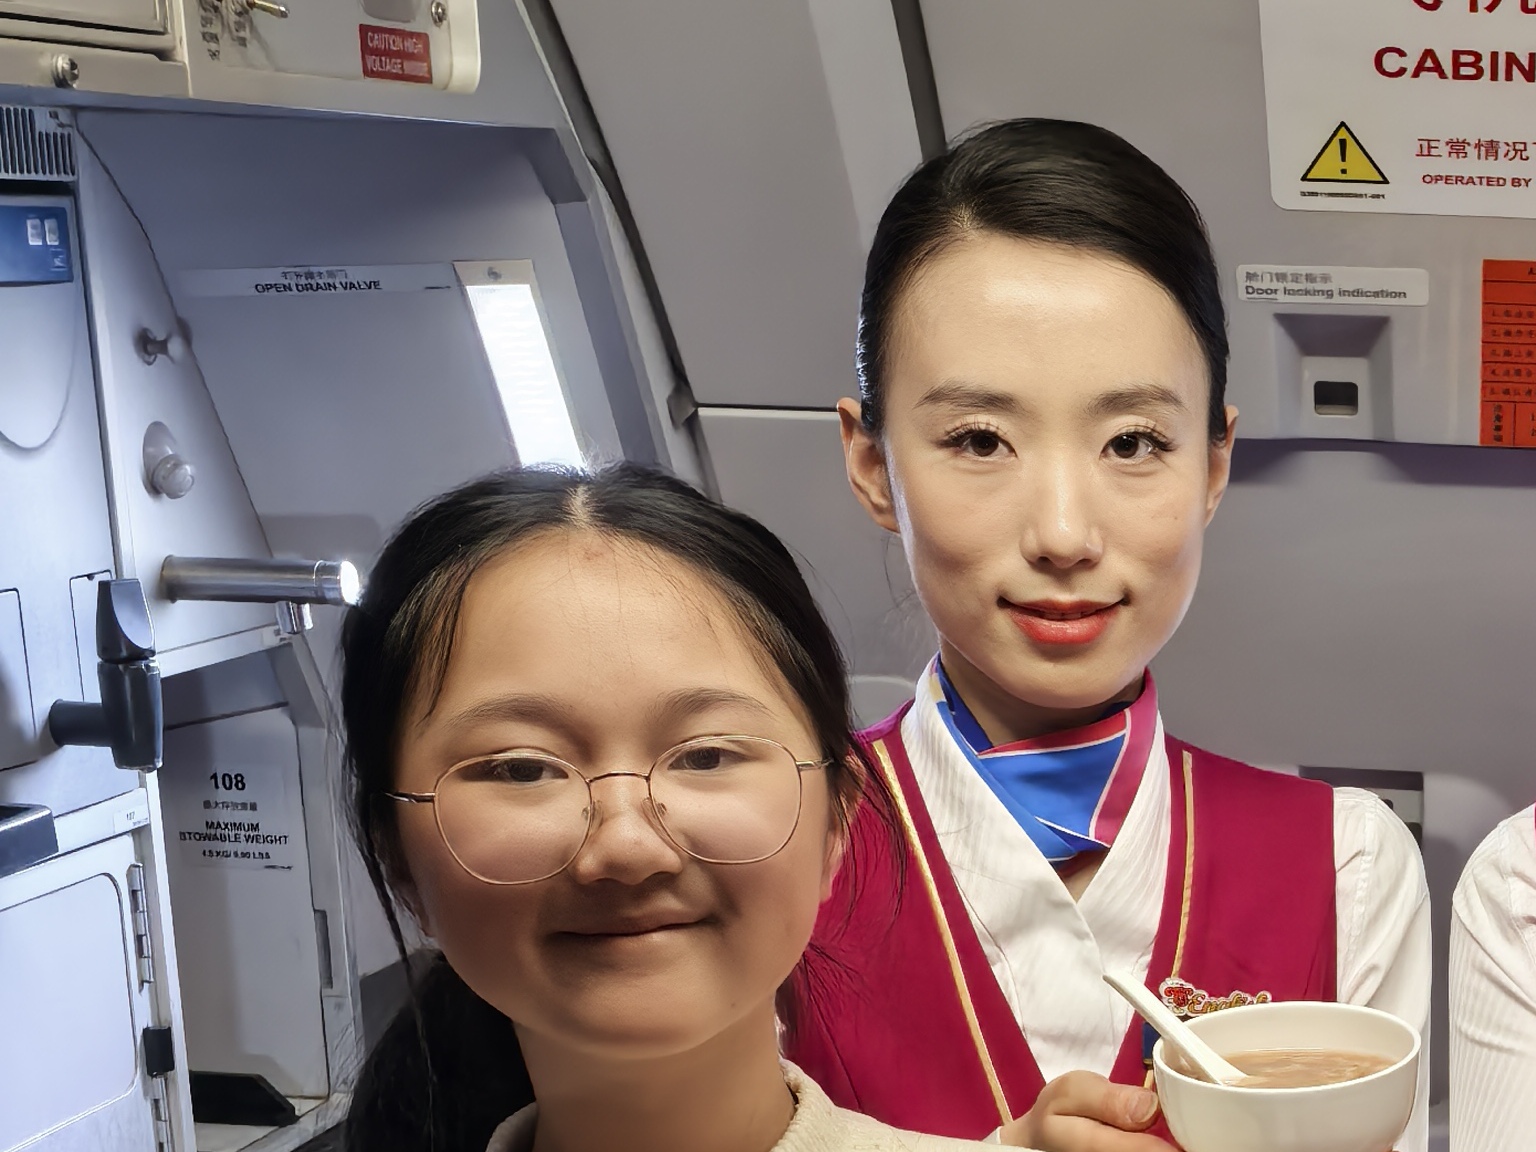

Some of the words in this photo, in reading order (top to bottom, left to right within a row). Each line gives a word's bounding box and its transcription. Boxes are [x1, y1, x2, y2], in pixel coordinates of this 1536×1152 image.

[367, 32, 403, 51] CAUTION
[365, 54, 402, 74] VOLTAGE
[1374, 46, 1536, 83] CABIN
[1422, 174, 1507, 187] OPERATED
[1511, 177, 1532, 188] BY
[254, 282, 293, 294] OPEN
[296, 281, 338, 292] DRAIN
[340, 280, 383, 291] VALVE
[1245, 285, 1279, 296] Door
[1283, 286, 1335, 299] locking
[1338, 287, 1407, 299] indication
[210, 772, 247, 791] 108
[205, 820, 260, 832] MAXIMUM
[244, 834, 289, 845] WEIGHT
